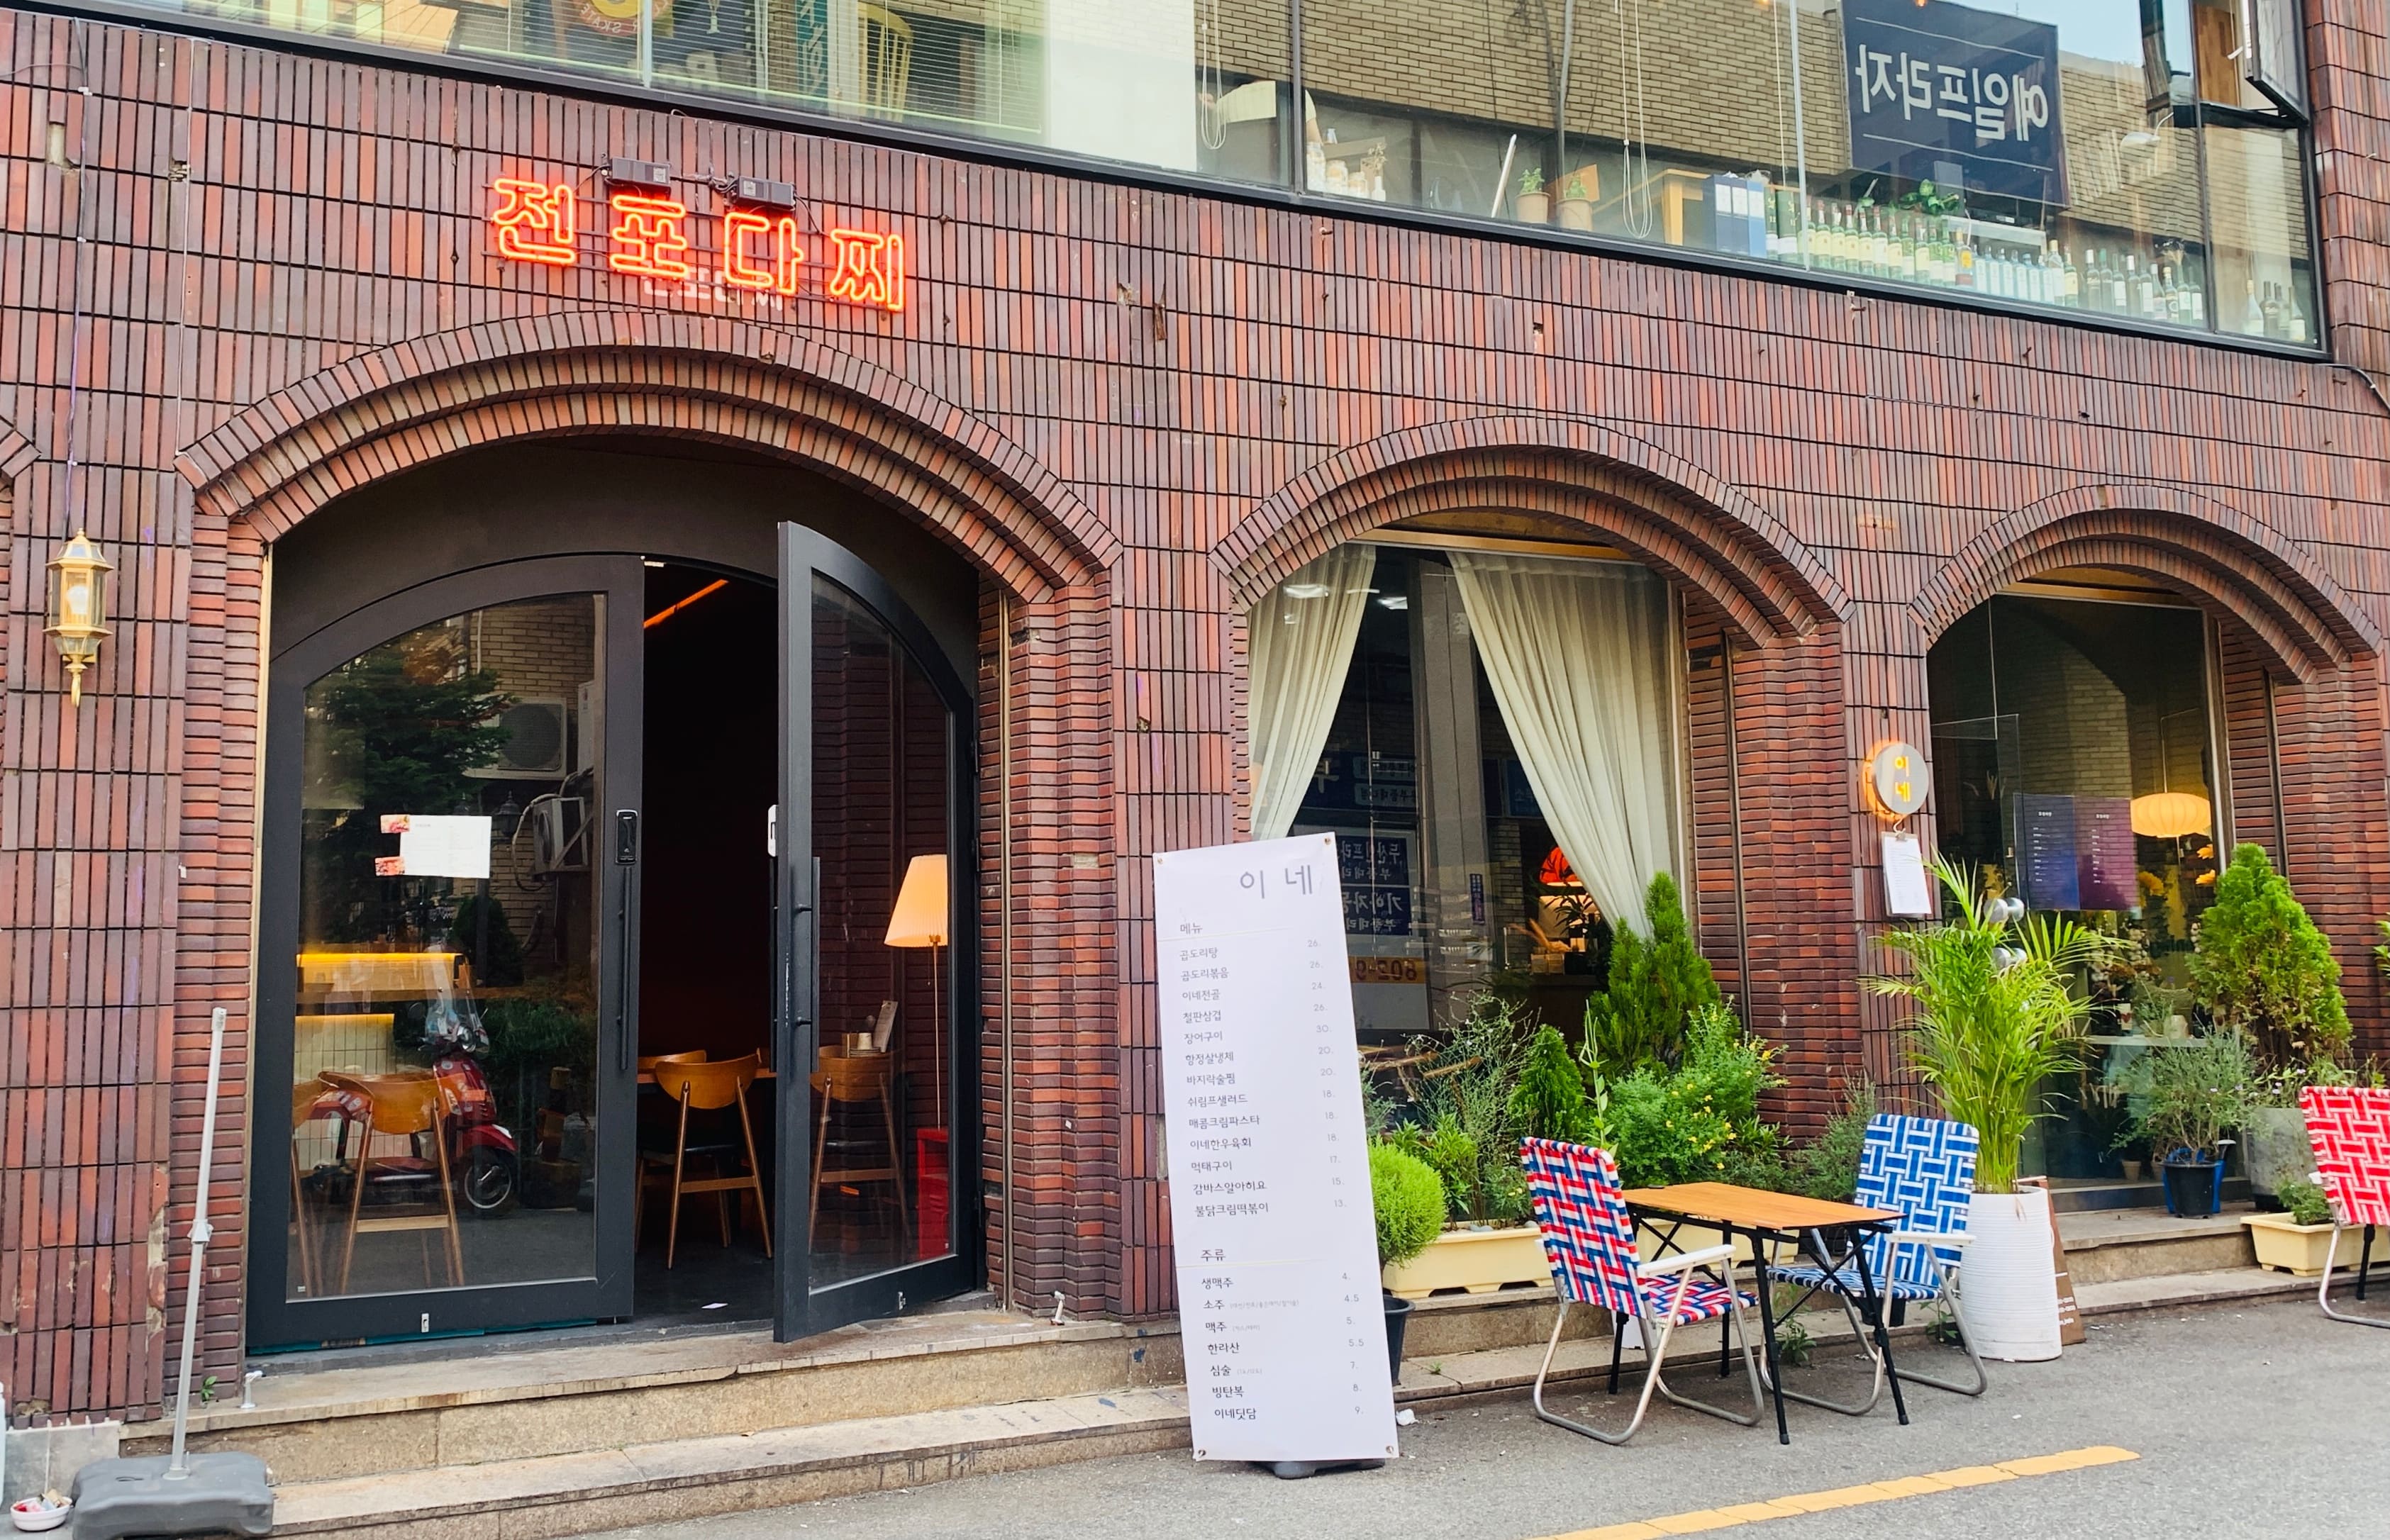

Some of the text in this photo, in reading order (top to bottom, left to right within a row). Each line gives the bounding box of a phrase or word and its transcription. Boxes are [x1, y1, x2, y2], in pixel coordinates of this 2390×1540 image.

[491, 177, 907, 313] 전포다찌
[1179, 922, 1204, 935] 메뉴
[1179, 947, 1219, 962] 곱도리탕
[1182, 988, 1221, 1002] 이네전골
[1183, 1024, 1332, 1045] 장어구이 30.
[1318, 1046, 1334, 1055] 20.
[1320, 1067, 1336, 1076] 20.
[1187, 1093, 1249, 1108] 쉬림프샐러드
[1189, 1114, 1260, 1130] 매콤크림파스타
[1189, 1137, 1252, 1151] 이네한우육회
[1191, 1159, 1233, 1174] 먹태구이
[1192, 1176, 1345, 1196] 감바스알아히요 15.
[1194, 1202, 1269, 1218] 불닭크림떡볶이
[1199, 1248, 1226, 1263] 주류
[1201, 1276, 1234, 1290] 생맥주
[1203, 1299, 1225, 1311] 소주
[1344, 1293, 1360, 1303] 4.5
[1205, 1321, 1228, 1334] 맥주
[1345, 1316, 1356, 1325] 5.
[1207, 1338, 1364, 1356] 한라산 5.5
[1210, 1364, 1232, 1378] 심술
[1212, 1383, 1362, 1400] 빙탄복 8.
